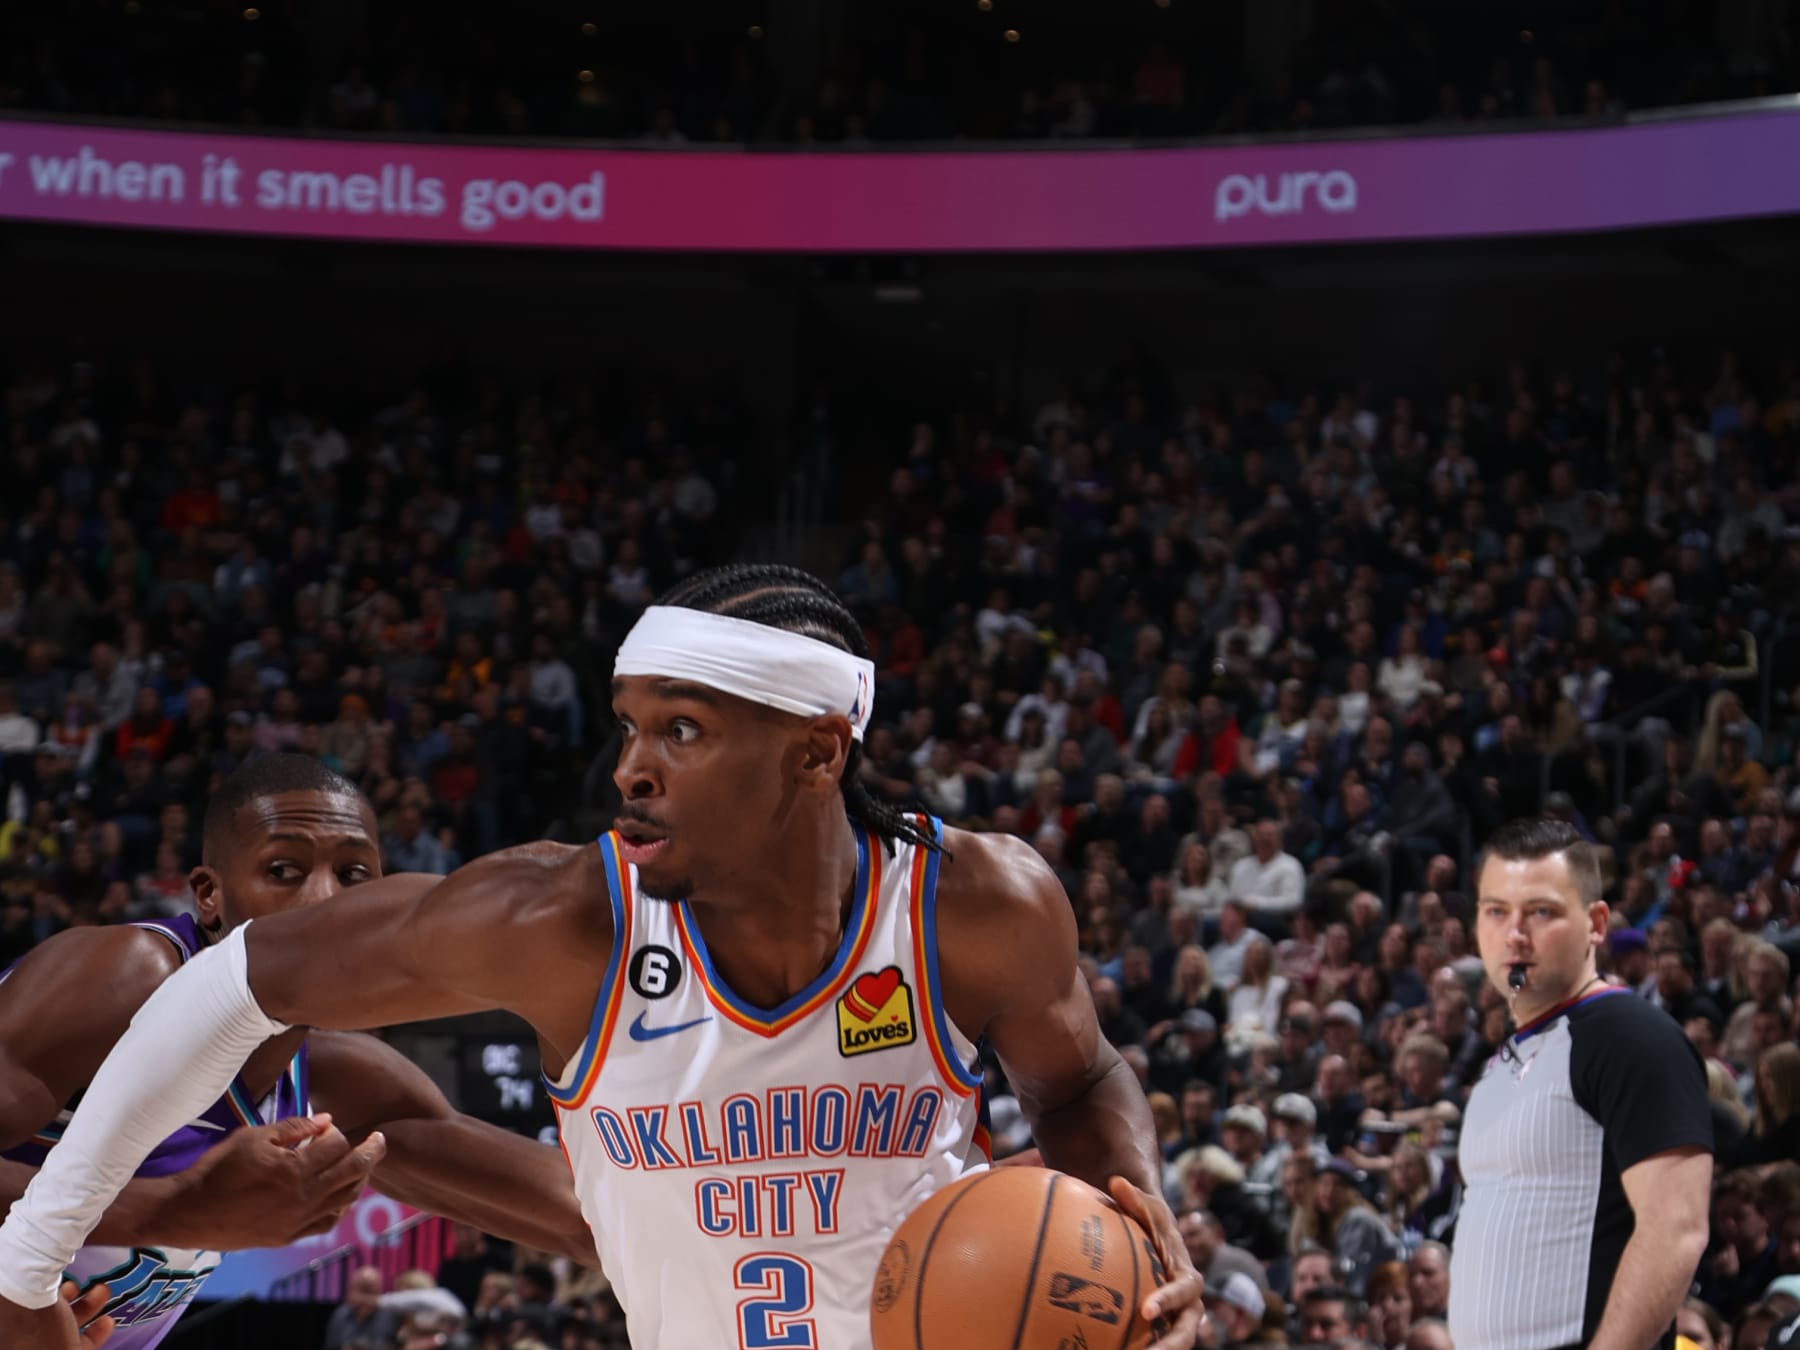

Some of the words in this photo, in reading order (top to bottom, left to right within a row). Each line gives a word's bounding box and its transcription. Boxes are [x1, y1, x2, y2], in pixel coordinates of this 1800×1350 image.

[29, 146, 185, 201] when
[201, 154, 242, 207] it
[257, 164, 446, 217] smells
[460, 171, 605, 231] good
[1215, 170, 1357, 222] pura
[638, 952, 670, 995] 6
[591, 1083, 944, 1171] OKLAHOMA
[695, 1168, 845, 1238] CITY
